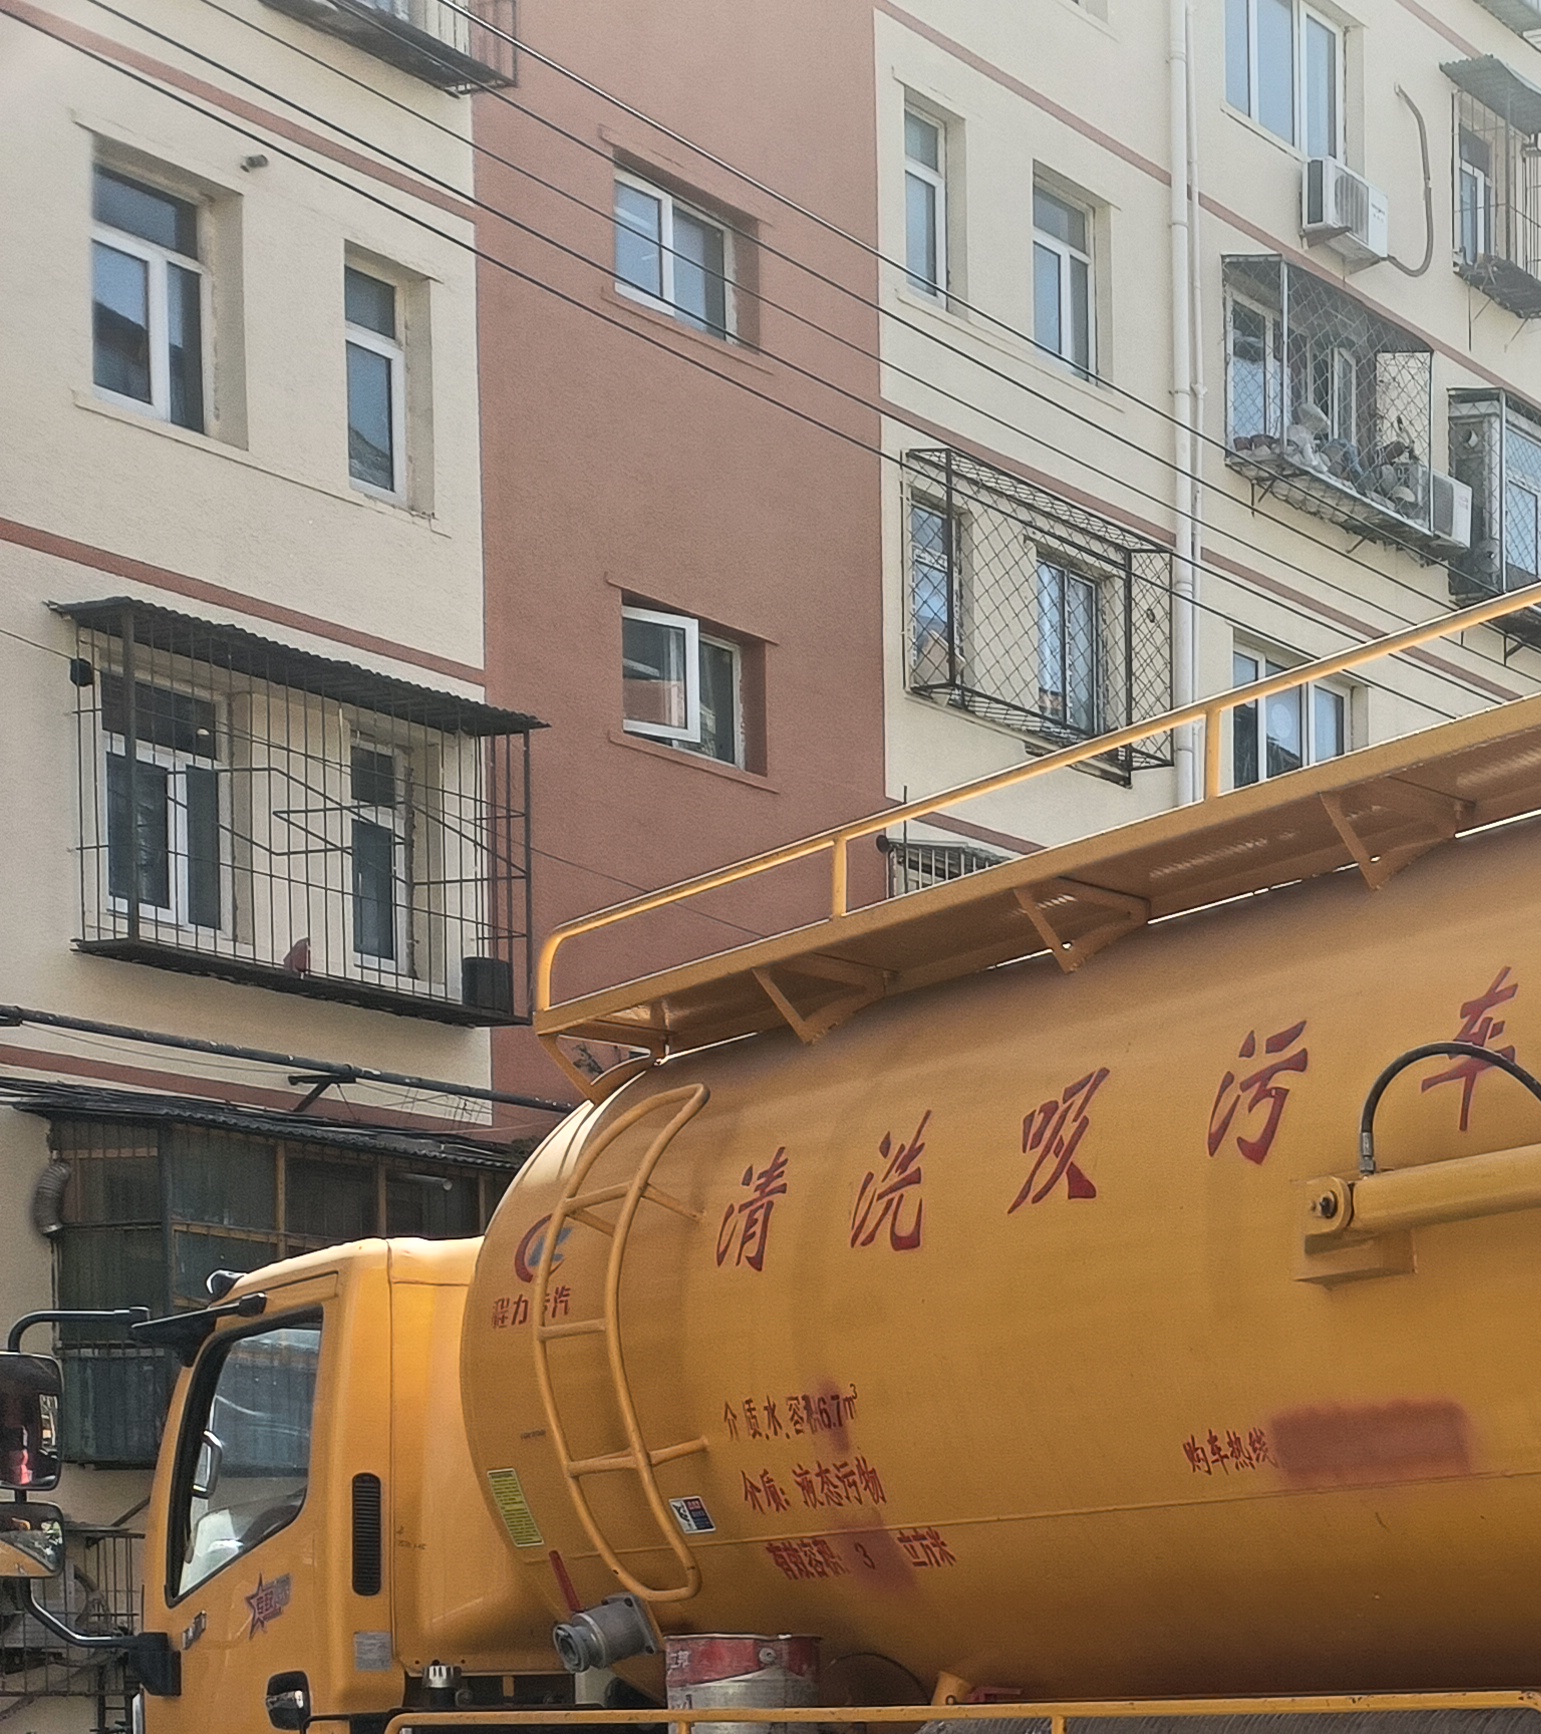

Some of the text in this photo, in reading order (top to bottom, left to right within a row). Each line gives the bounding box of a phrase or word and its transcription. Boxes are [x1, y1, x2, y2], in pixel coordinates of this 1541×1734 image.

[492, 1285, 571, 1329] 程力汽
[1183, 1426, 1280, 1476] 购车热线
